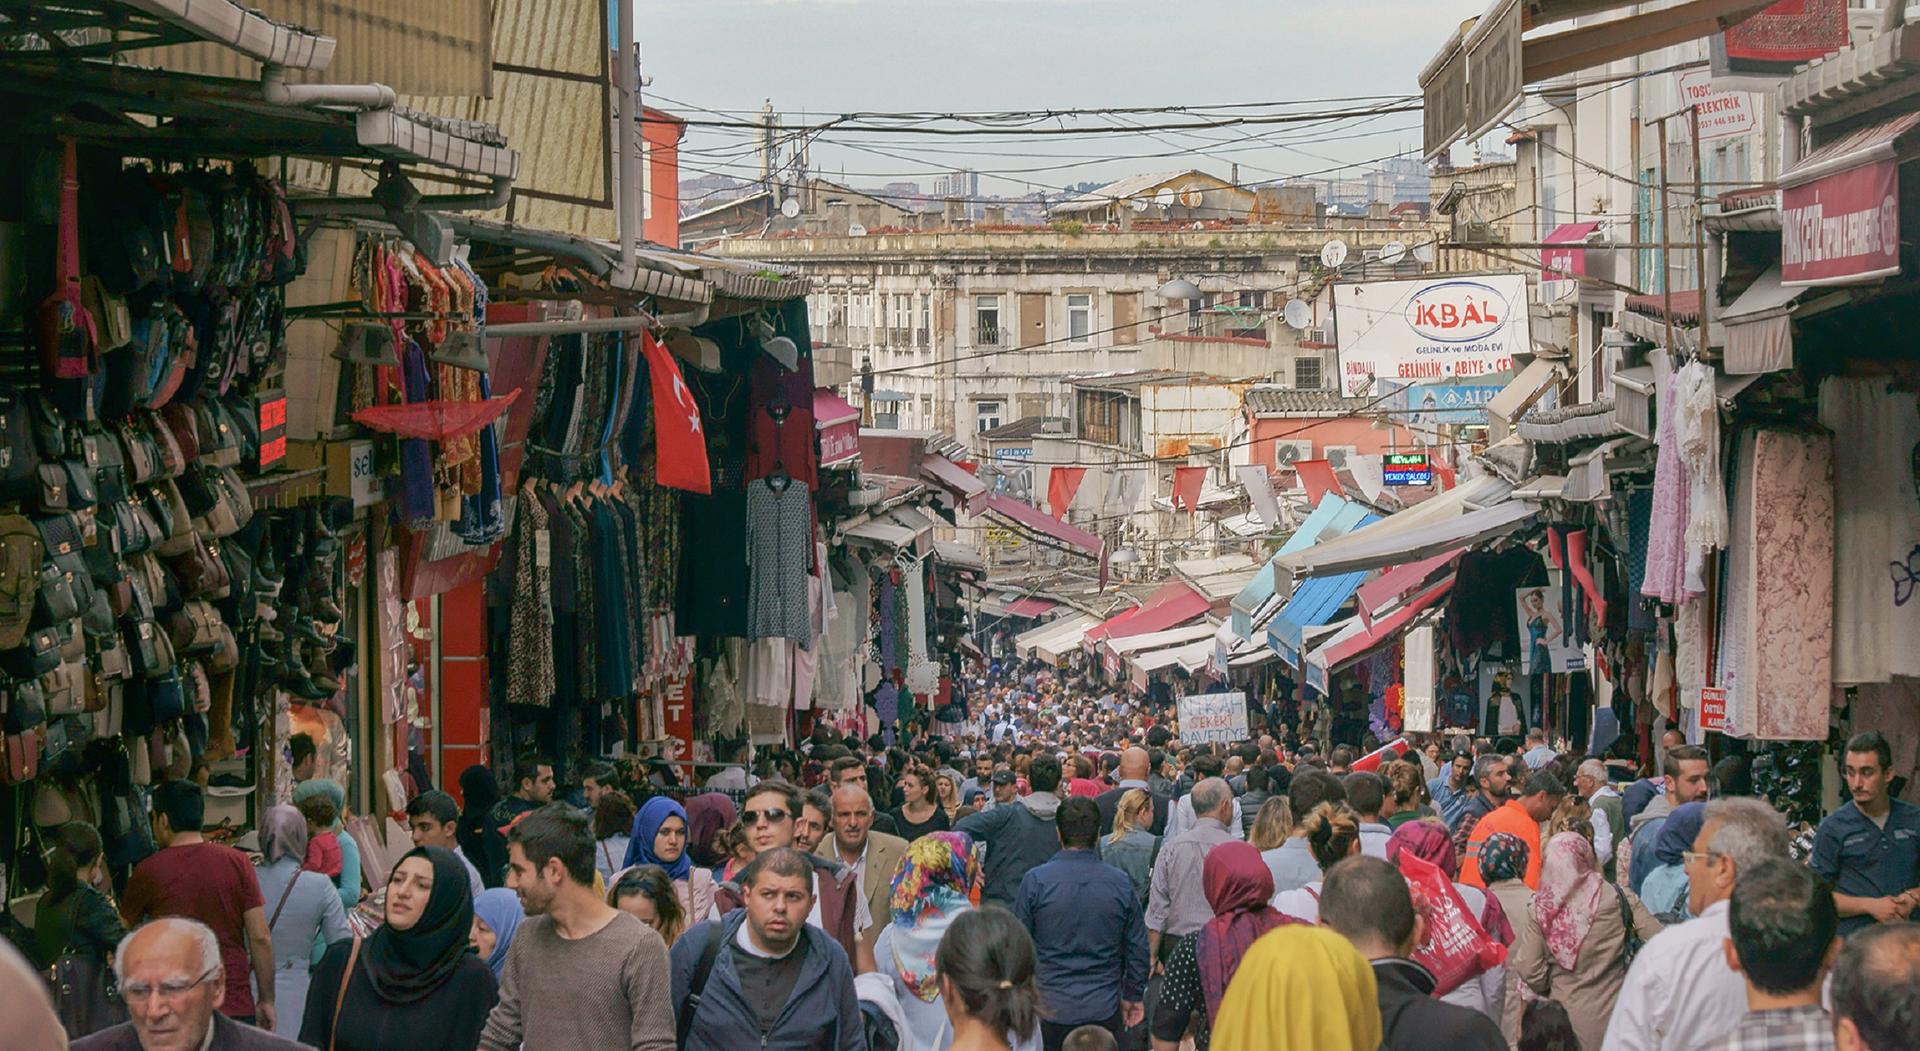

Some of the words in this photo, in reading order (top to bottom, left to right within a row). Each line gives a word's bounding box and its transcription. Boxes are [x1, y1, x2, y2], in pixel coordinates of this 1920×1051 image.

[1696, 94, 1741, 115] ELEKTRİK
[1416, 344, 1450, 355] GELİNLİK
[1464, 344, 1490, 353] MODA
[1398, 359, 1442, 378] GELİNLİK
[1455, 357, 1484, 375] ABİYE
